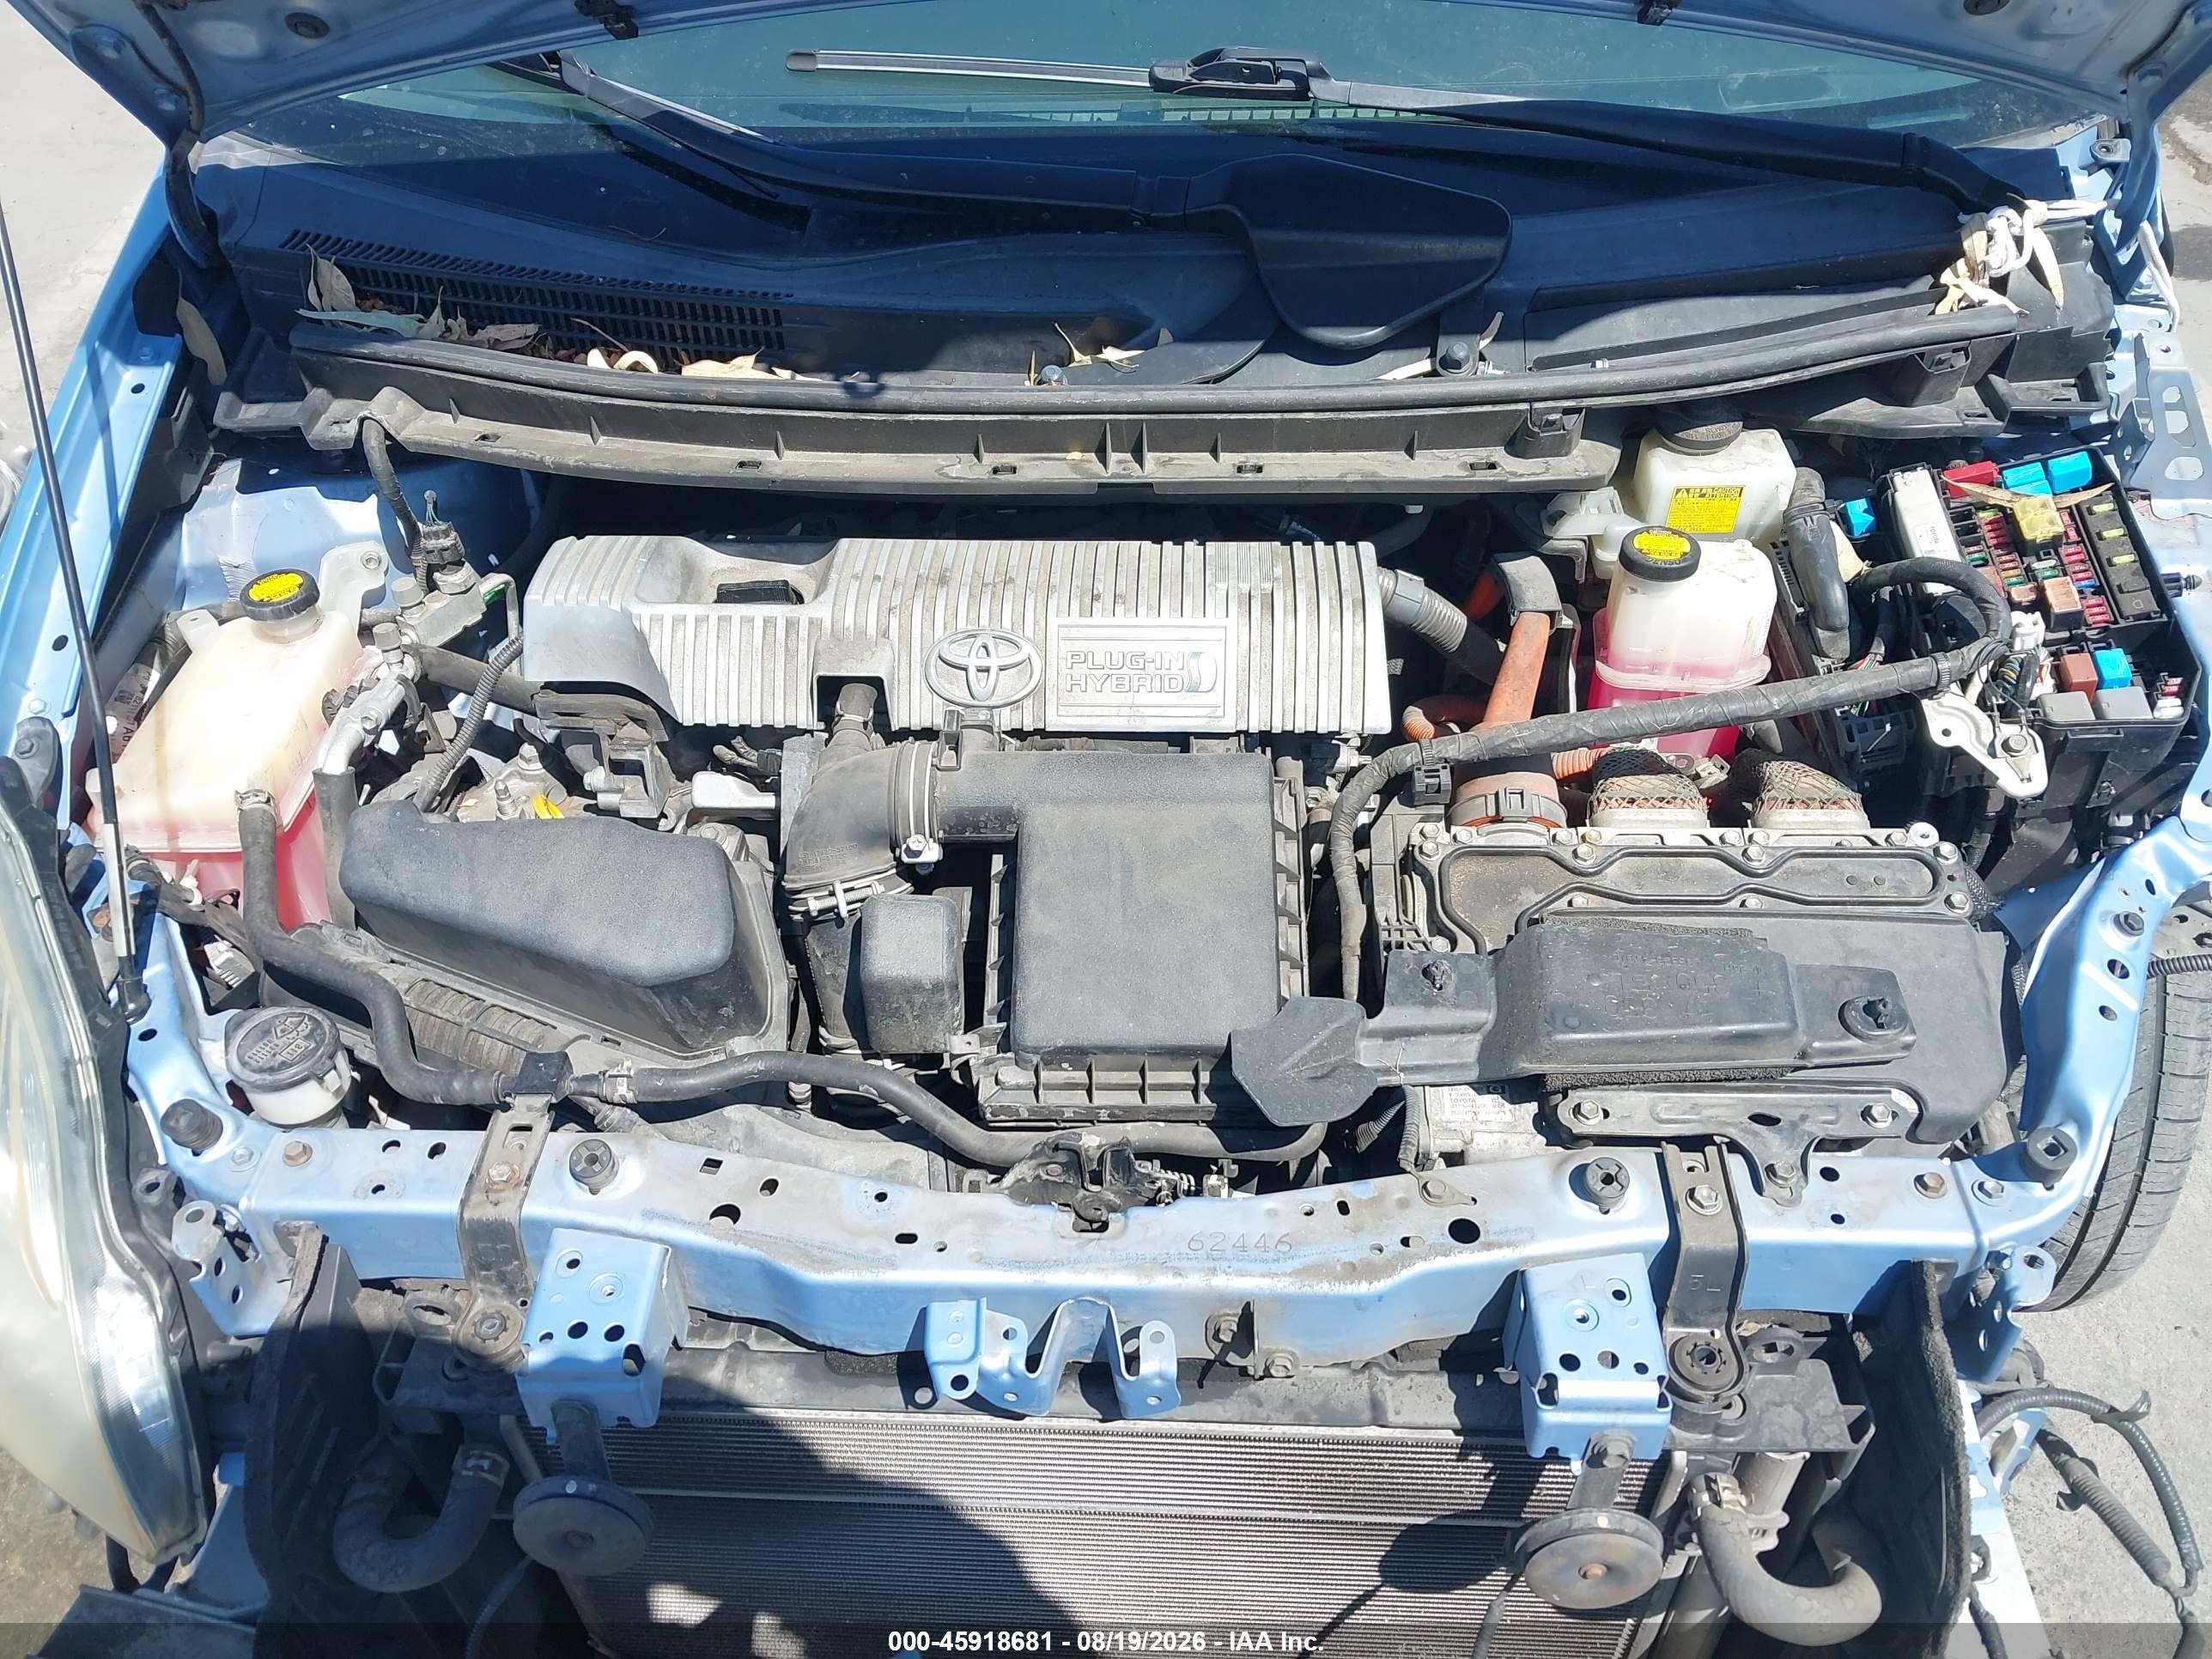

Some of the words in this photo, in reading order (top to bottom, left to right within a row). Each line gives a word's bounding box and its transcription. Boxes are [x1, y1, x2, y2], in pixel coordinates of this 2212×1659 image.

[1066, 650, 1184, 670] PLUG-IN
[1066, 673, 1185, 693] HYBRID
[1188, 1231, 1292, 1253] 62446
